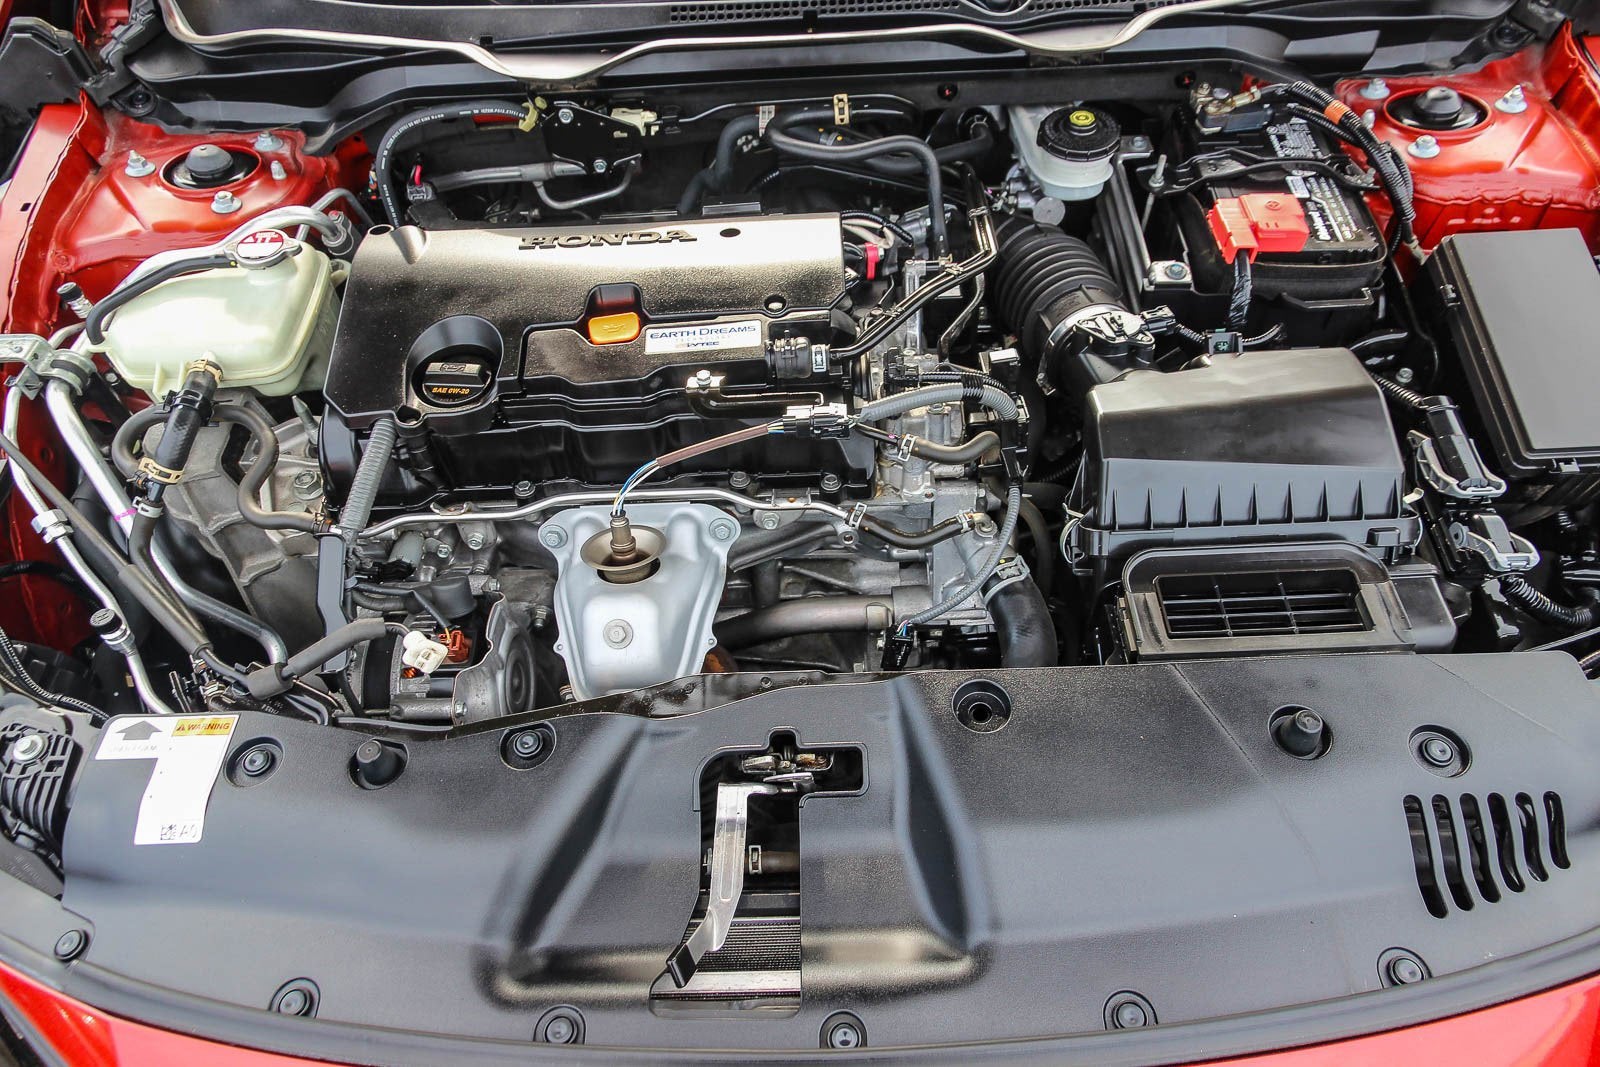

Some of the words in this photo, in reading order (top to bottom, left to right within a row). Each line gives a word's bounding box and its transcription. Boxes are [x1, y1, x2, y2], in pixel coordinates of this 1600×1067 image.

[518, 229, 697, 250] HONDA
[650, 330, 696, 339] EARTH
[699, 326, 756, 336] DREAMS
[188, 722, 230, 731] WARNING
